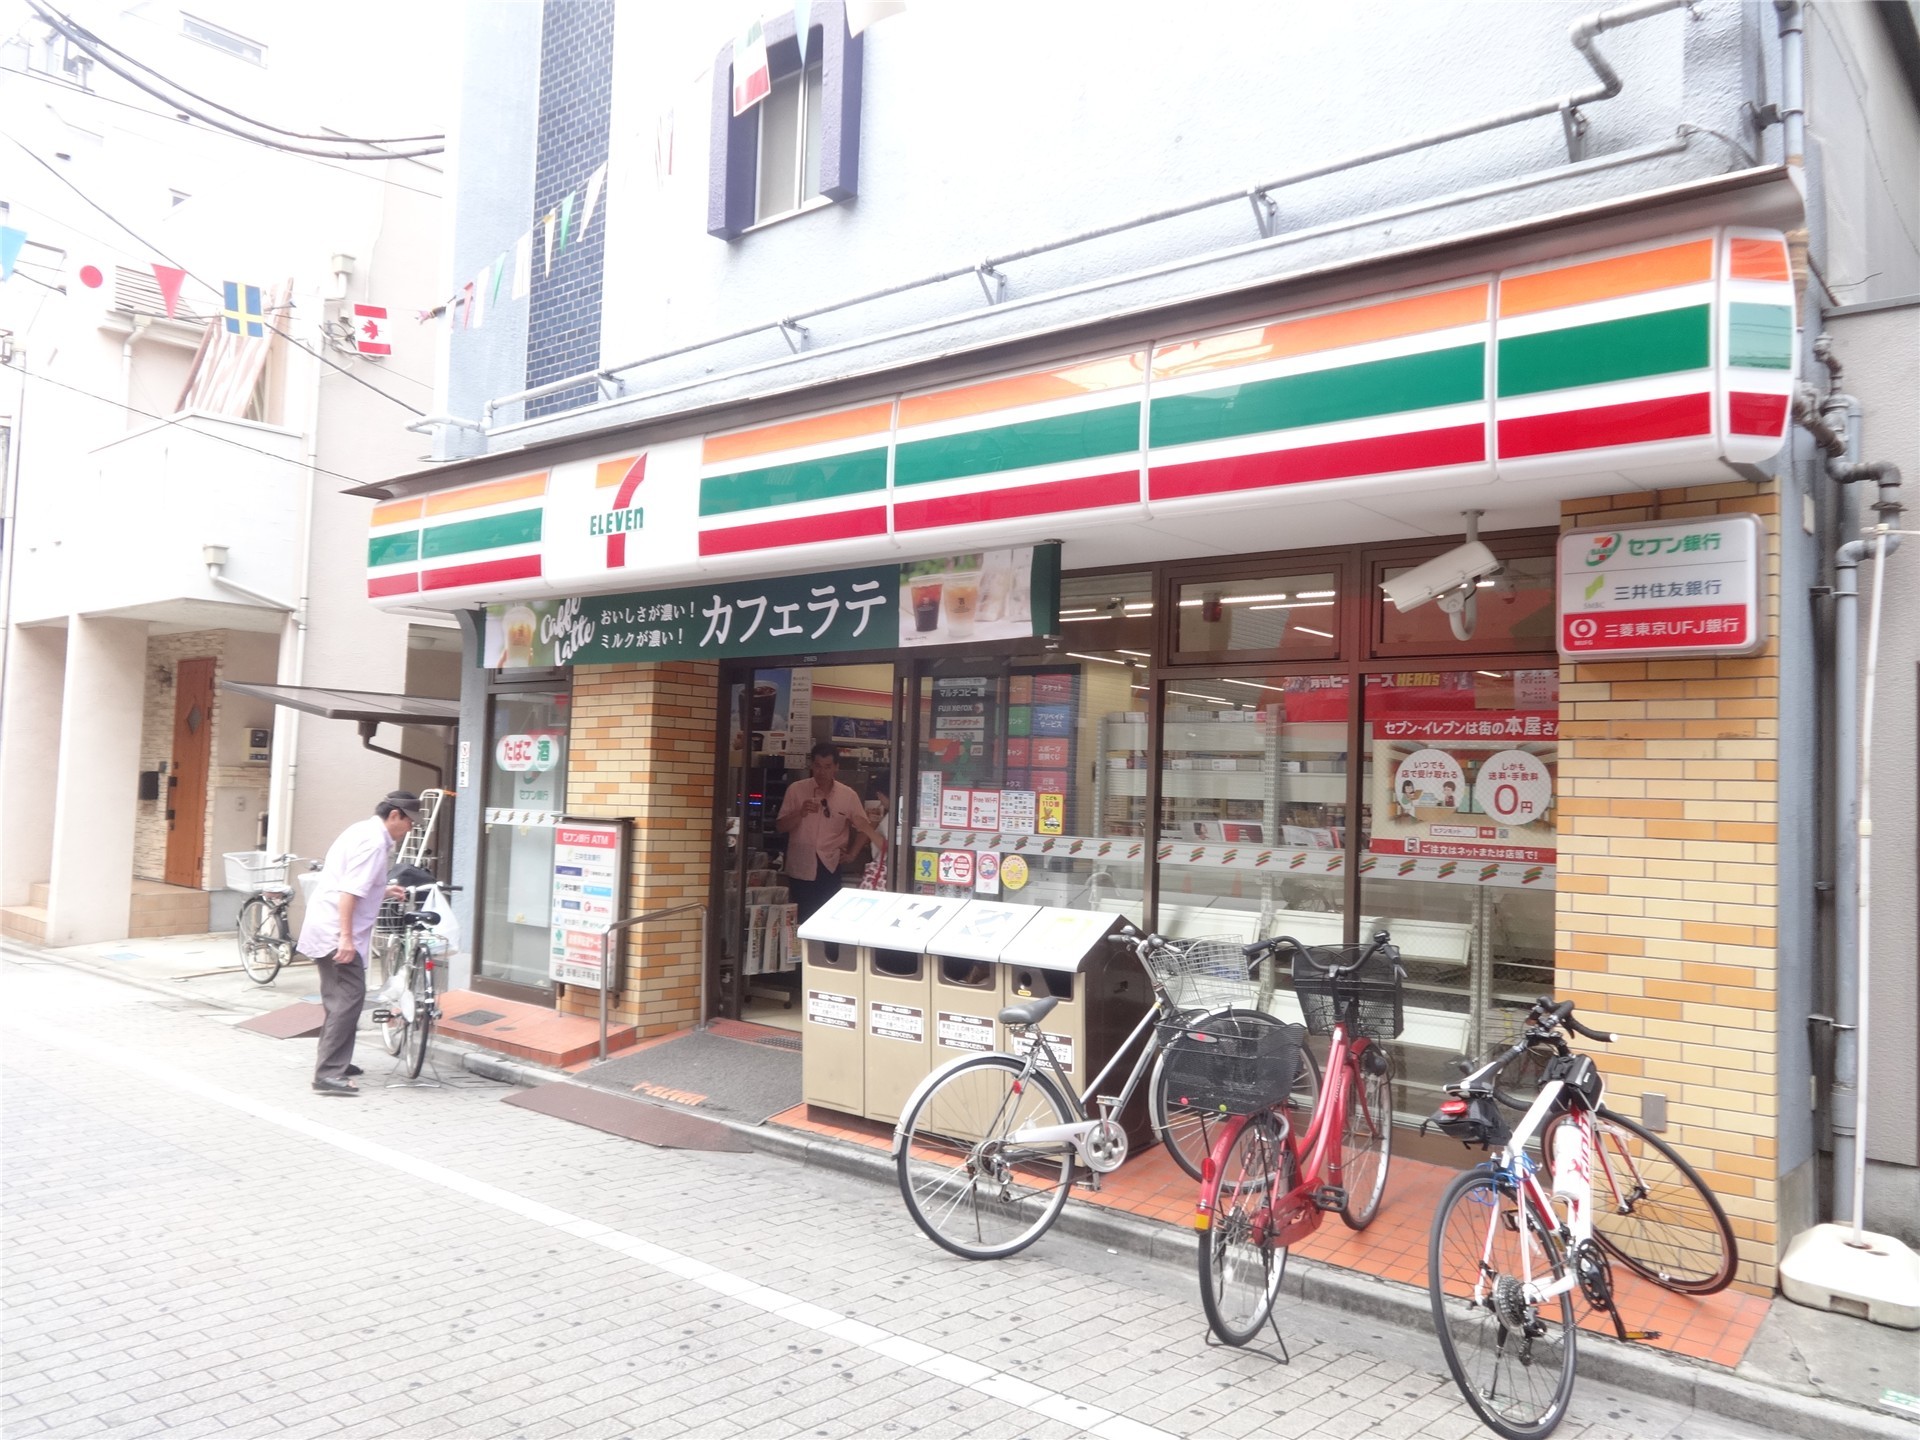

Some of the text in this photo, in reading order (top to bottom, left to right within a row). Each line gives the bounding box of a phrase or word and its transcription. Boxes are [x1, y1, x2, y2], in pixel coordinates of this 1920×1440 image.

[1628, 533, 1722, 557] セブン銀行
[1614, 580, 1723, 601] 三井住友銀行
[699, 580, 888, 648] カフェラテ
[1604, 618, 1740, 638] 三菱東京UFJ銀行
[554, 615, 596, 667] Latte
[504, 741, 531, 761] たばこ
[537, 740, 550, 761] 酒
[1401, 770, 1459, 779] 店で受け取れる
[1414, 761, 1446, 770] いつでも
[1501, 762, 1527, 771] しかも
[520, 790, 549, 800] セブン銀行
[1494, 784, 1534, 816] 0円
[591, 834, 609, 845] ATM
